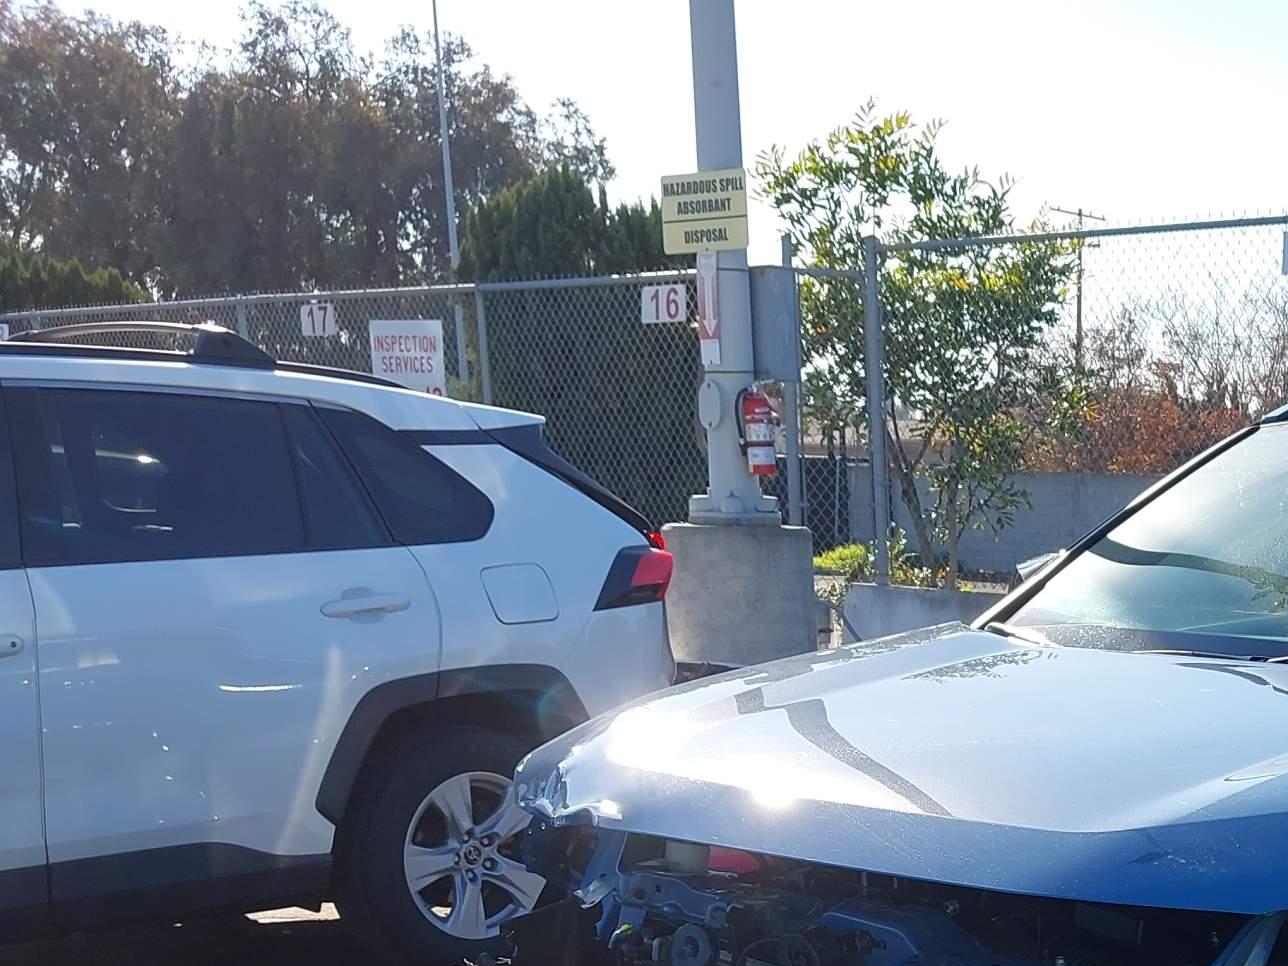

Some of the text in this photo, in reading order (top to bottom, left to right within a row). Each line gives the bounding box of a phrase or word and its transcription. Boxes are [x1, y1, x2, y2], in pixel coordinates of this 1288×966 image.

[663, 176, 743, 197] HAZARDOUS SPILL
[677, 198, 731, 216] ABSORBANT
[684, 228, 728, 244] DISPOSAL
[651, 287, 679, 321] 16
[307, 306, 327, 334] 17
[374, 336, 436, 352] INSPECTION
[382, 356, 433, 373] SERVICES
